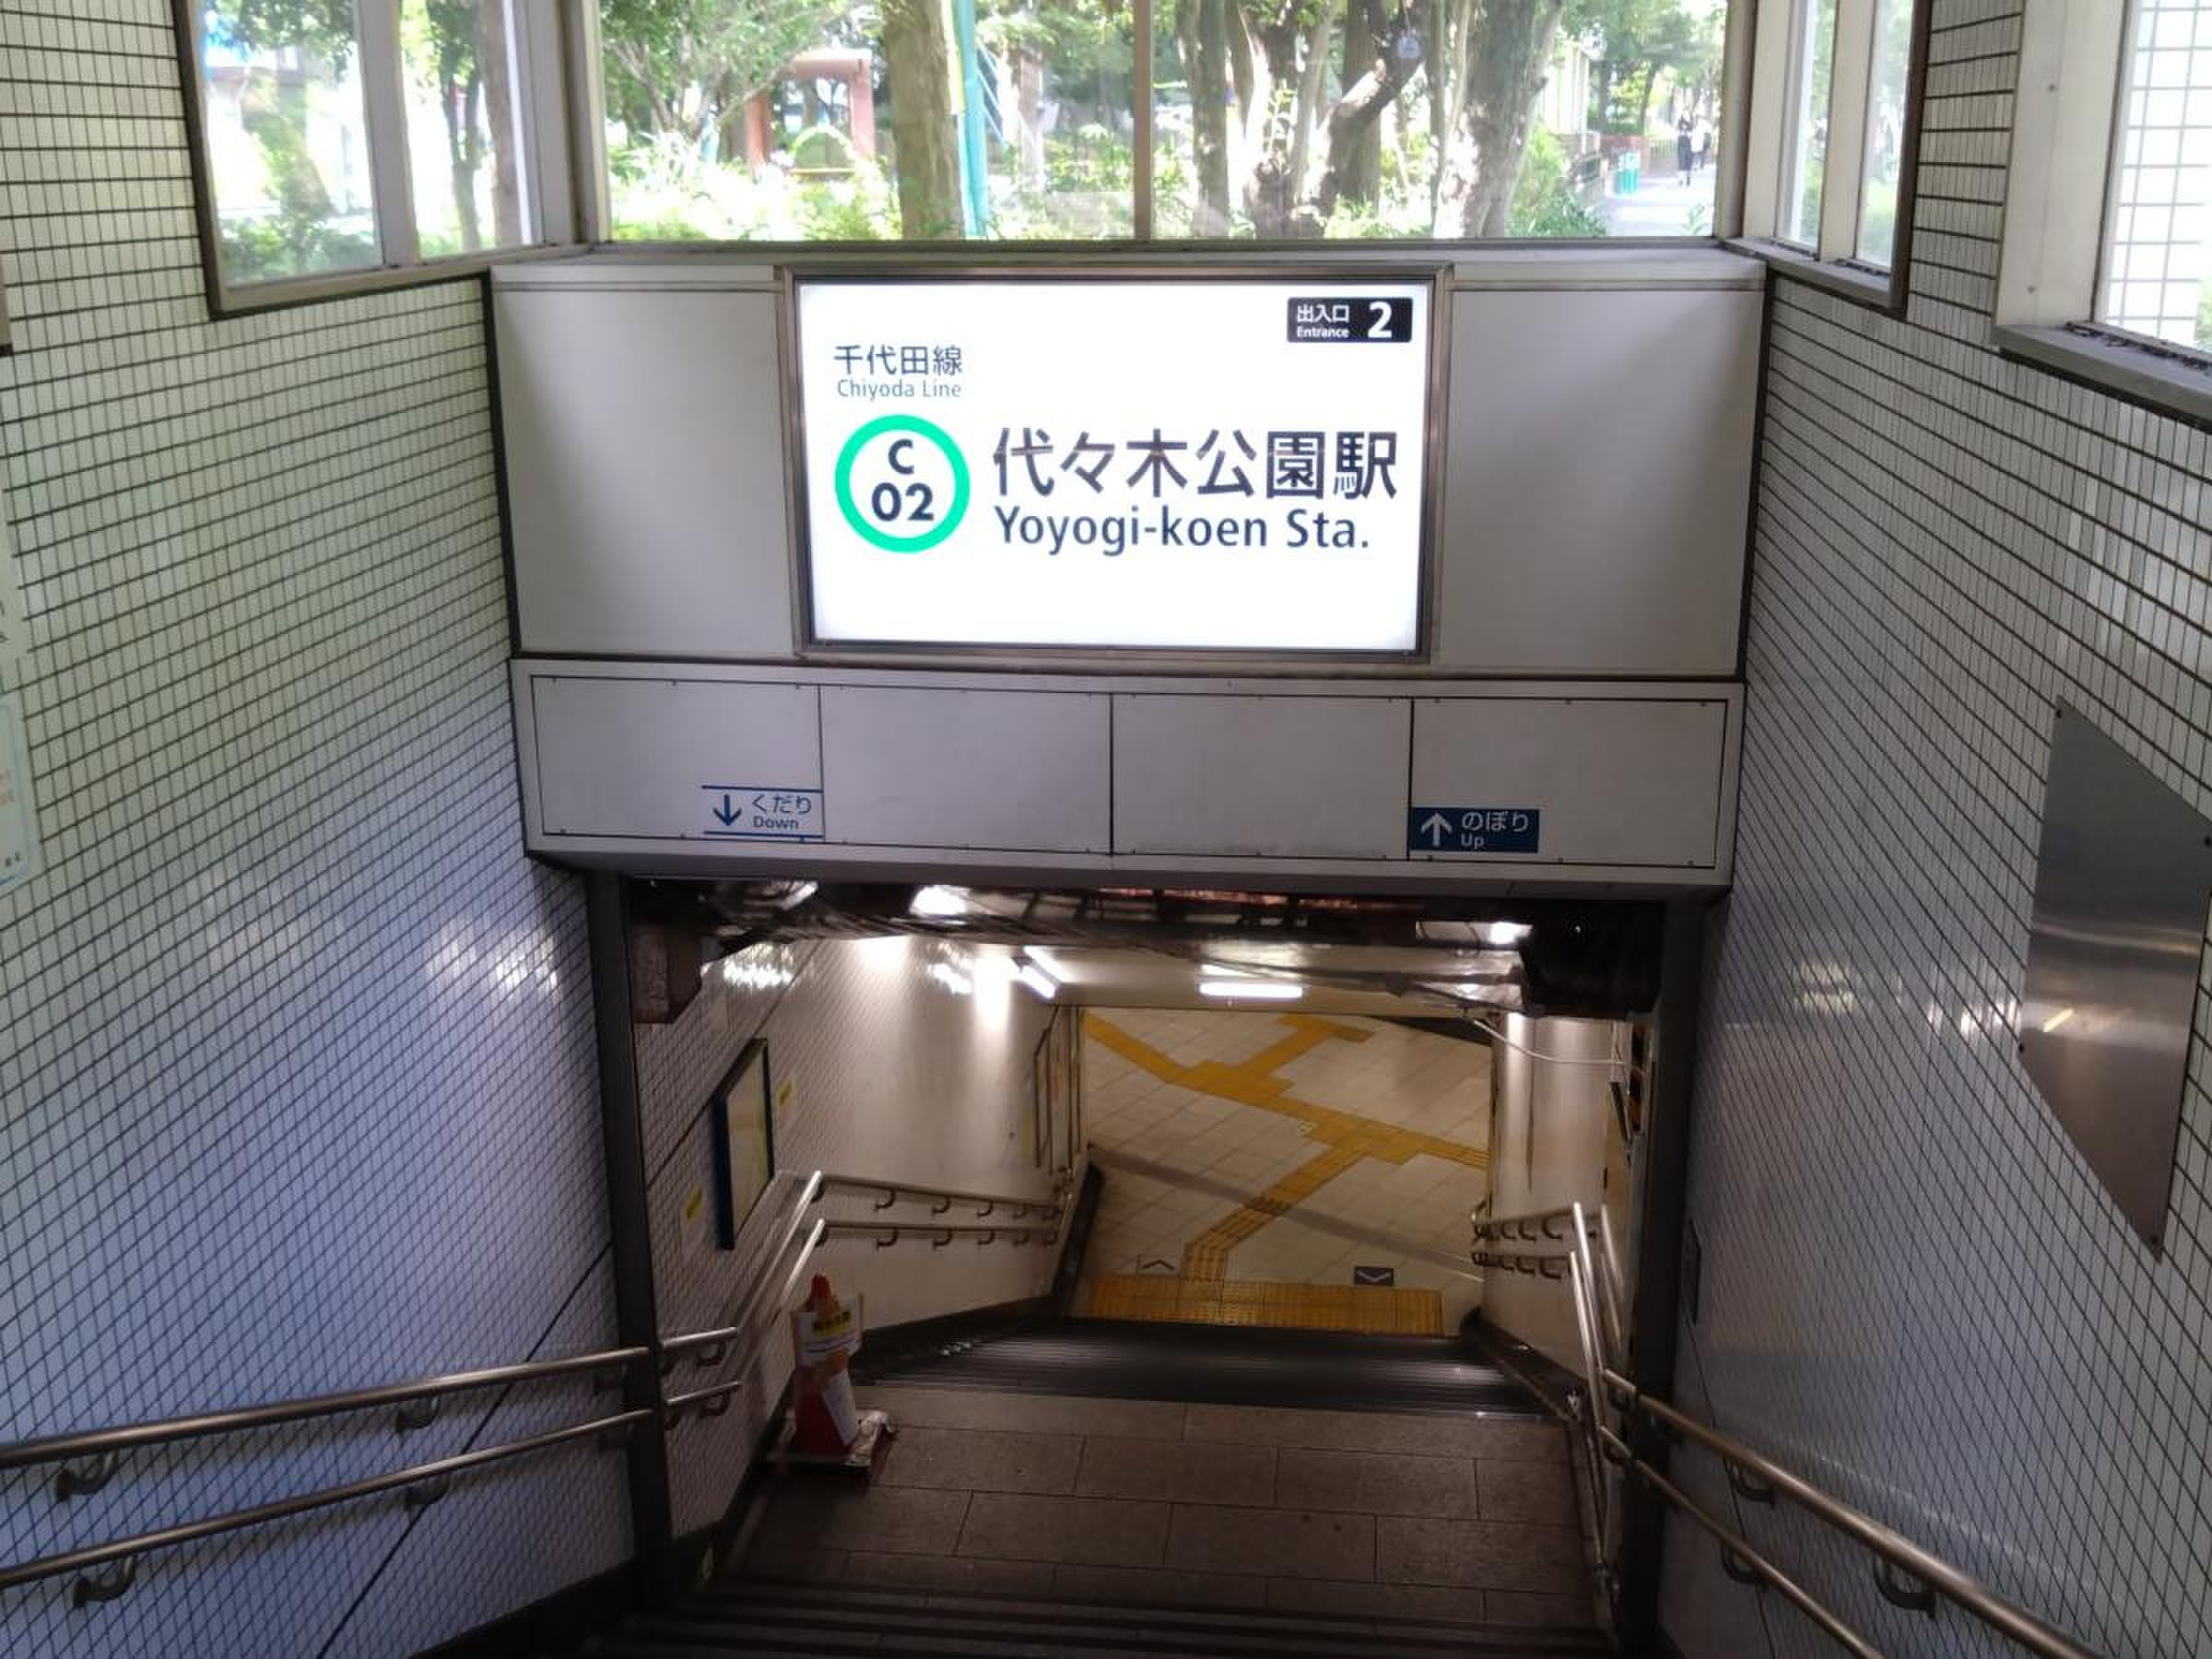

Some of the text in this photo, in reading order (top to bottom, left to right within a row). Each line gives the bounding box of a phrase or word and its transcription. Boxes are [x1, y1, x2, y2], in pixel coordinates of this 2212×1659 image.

[1296, 303, 1350, 324] 出入口
[1367, 300, 1393, 339] 2
[1296, 325, 1350, 338] Entrance
[832, 344, 964, 376] 千代田線
[837, 378, 962, 403] Chiyoda Line
[887, 438, 915, 476] C
[993, 427, 1398, 500] 代々木公園駅
[871, 481, 935, 522] 02
[994, 505, 1371, 557] Yoyogi-koen Sta.
[751, 794, 812, 815] くだり
[752, 816, 799, 830] Down
[1461, 810, 1529, 832] のぼり
[1460, 833, 1485, 850] Up
